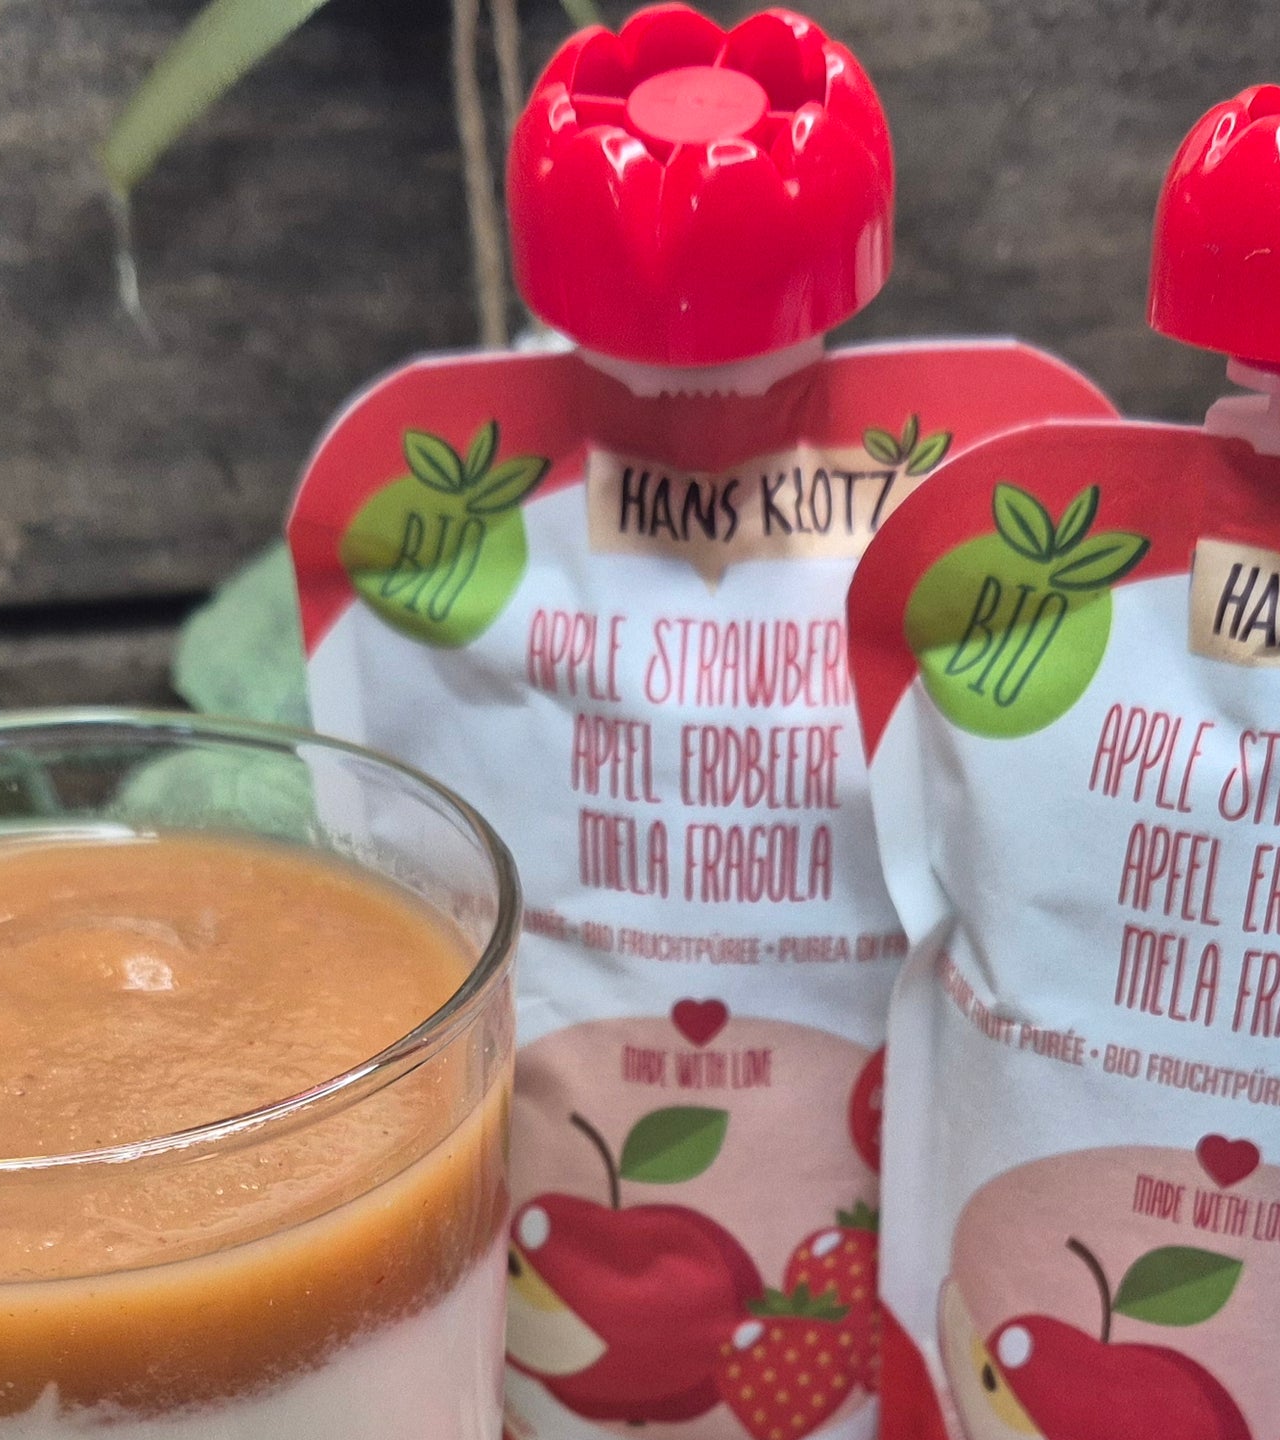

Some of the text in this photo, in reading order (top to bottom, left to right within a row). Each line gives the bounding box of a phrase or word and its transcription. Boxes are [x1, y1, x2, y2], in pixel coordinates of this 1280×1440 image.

[619, 467, 897, 543] HANS KLOTZ
[381, 511, 487, 622] BIO
[525, 609, 627, 702] APPLE
[944, 574, 1068, 708] BIO
[571, 712, 844, 809] APFEL ERDBEERE
[1088, 703, 1214, 813] APPLE
[578, 807, 833, 903] MELA FRAGOLA
[1118, 822, 1221, 926] APFEL
[1114, 924, 1219, 1027] MELA
[1103, 1043, 1142, 1078] BIO
[1132, 1172, 1186, 1225] MADE
[1192, 1188, 1250, 1237] WITH
